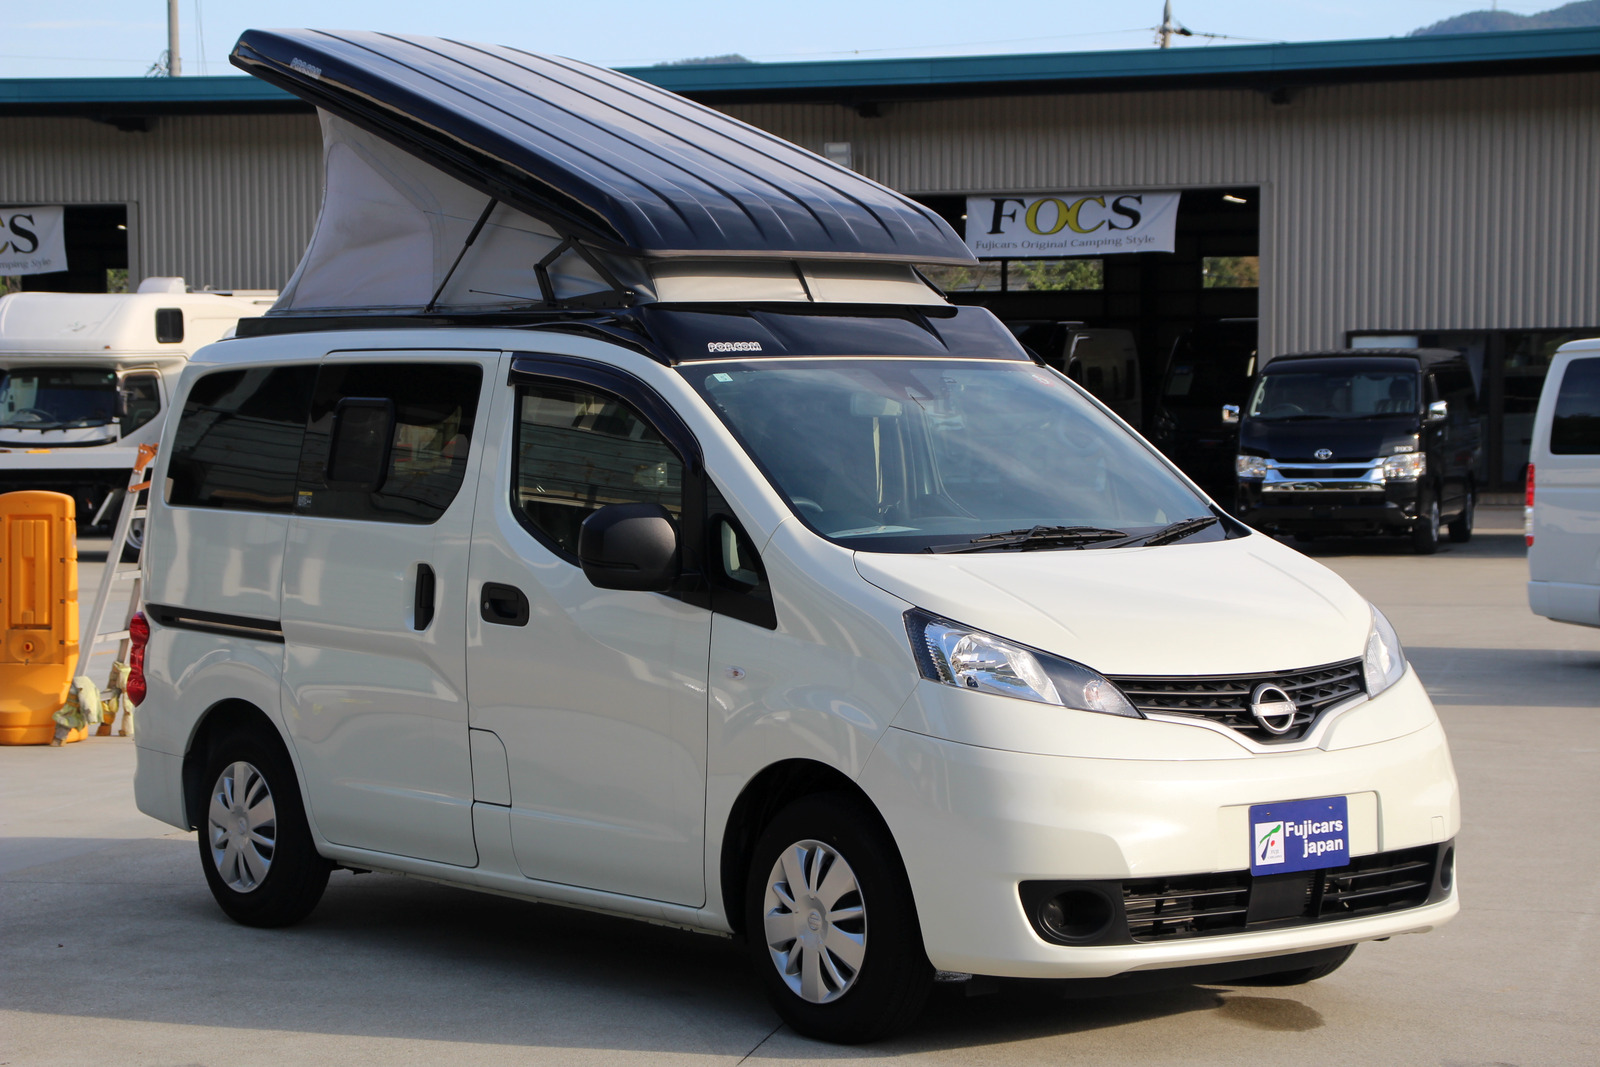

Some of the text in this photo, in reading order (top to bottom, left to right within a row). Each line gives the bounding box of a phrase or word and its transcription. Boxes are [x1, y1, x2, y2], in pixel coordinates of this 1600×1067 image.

[986, 195, 1142, 235] FOCS
[975, 234, 1155, 251] Fujicars Original Camping Style
[1253, 703, 1297, 714] NSAN
[1285, 819, 1344, 840] Fujicars
[1302, 838, 1344, 858] japan
